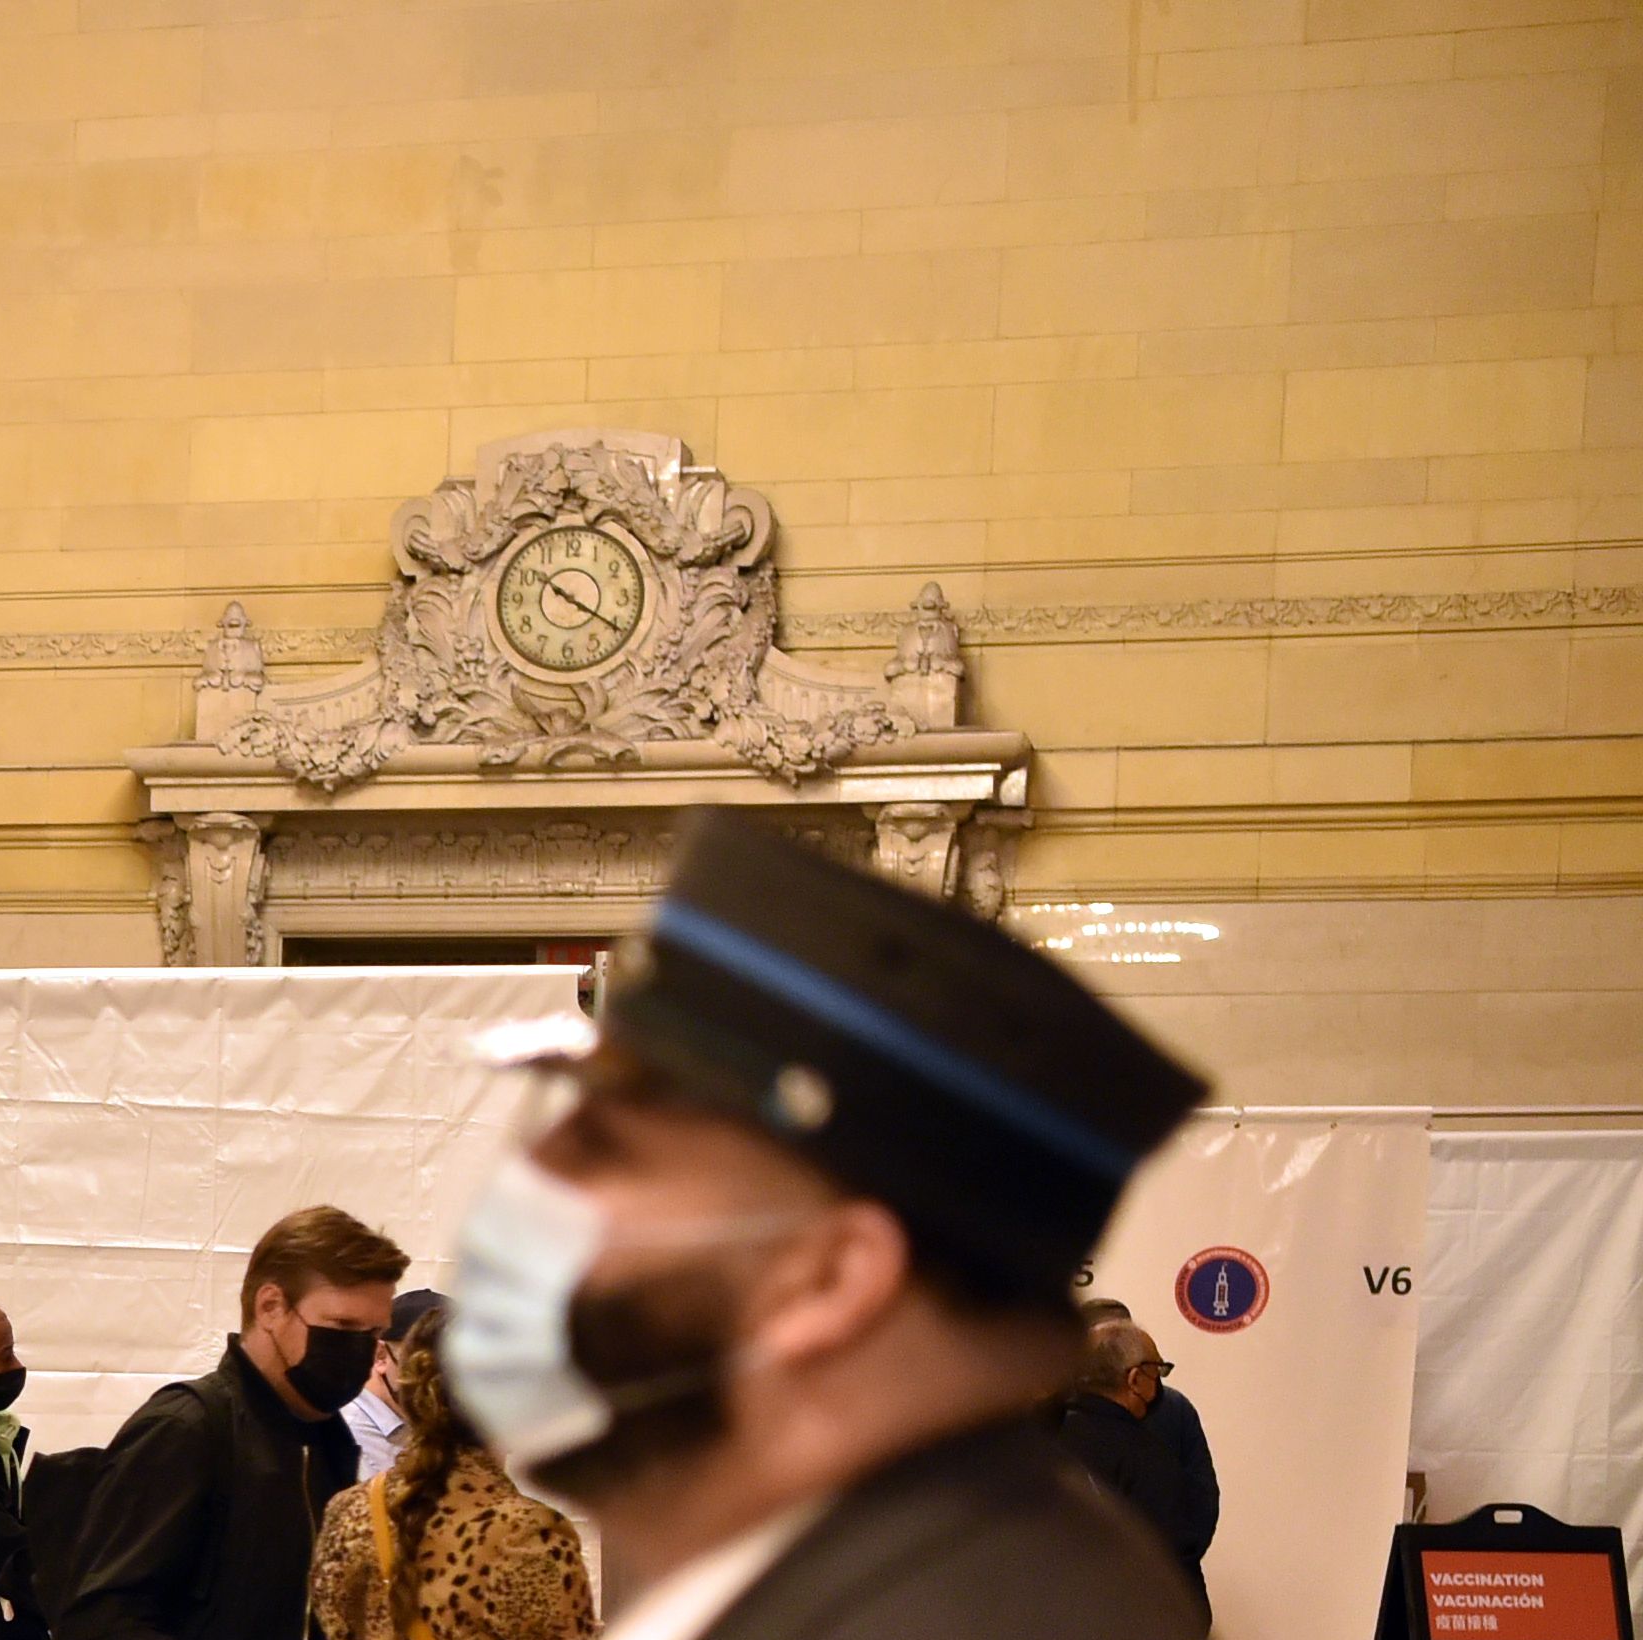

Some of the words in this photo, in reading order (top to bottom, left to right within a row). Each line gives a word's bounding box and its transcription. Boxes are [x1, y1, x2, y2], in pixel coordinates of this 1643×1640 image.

[541, 547, 553, 564] 11
[565, 538, 582, 557] 12
[519, 570, 535, 587] 10
[609, 560, 621, 579] 2
[512, 592, 524, 609] 9
[616, 588, 629, 607] 3
[520, 616, 532, 634] 8
[537, 635, 549, 654] 7
[562, 640, 574, 660] 6
[586, 634, 601, 653] 5
[1363, 1266, 1412, 1295] V6
[1430, 1573, 1544, 1587] VACCINATION
[1432, 1593, 1544, 1608] VACUNACIÓN
